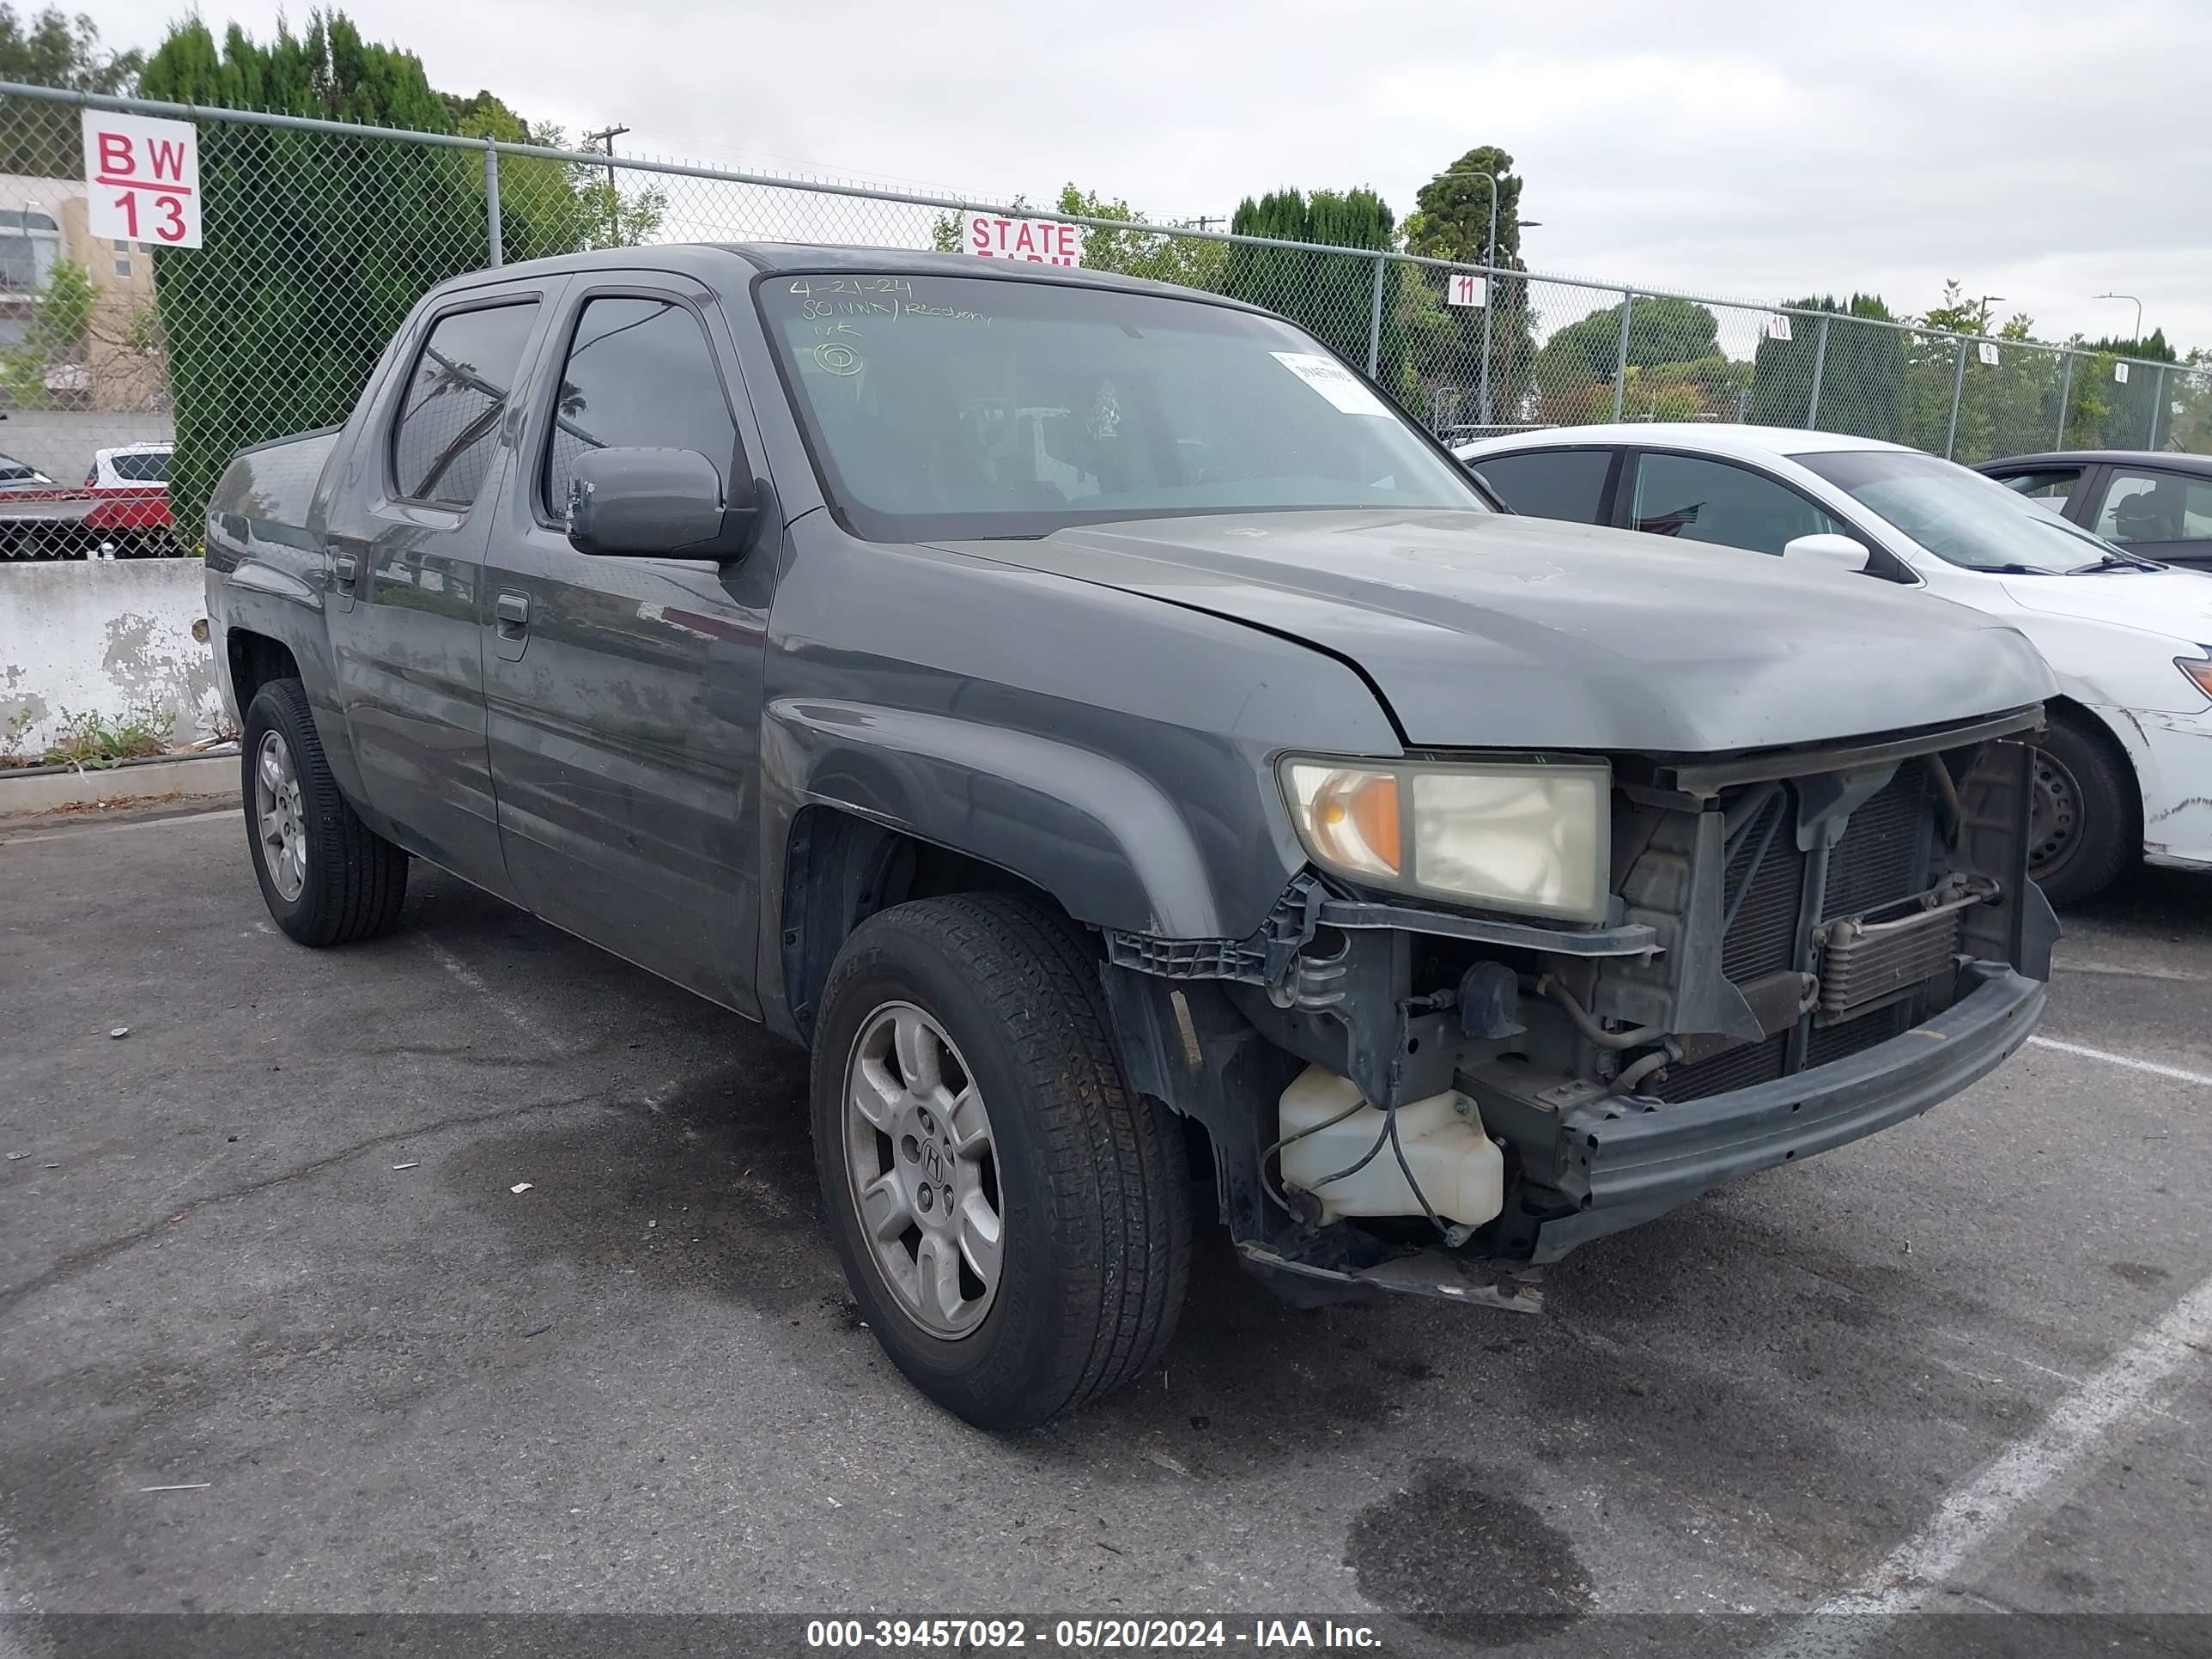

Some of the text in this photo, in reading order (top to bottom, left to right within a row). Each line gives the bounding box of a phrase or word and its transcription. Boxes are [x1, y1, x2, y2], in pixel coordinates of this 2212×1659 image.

[114, 190, 186, 242] 13
[972, 218, 1075, 255] STATE
[1458, 276, 1474, 303] 11
[1773, 316, 1786, 337] 10
[1985, 344, 1992, 362] 9
